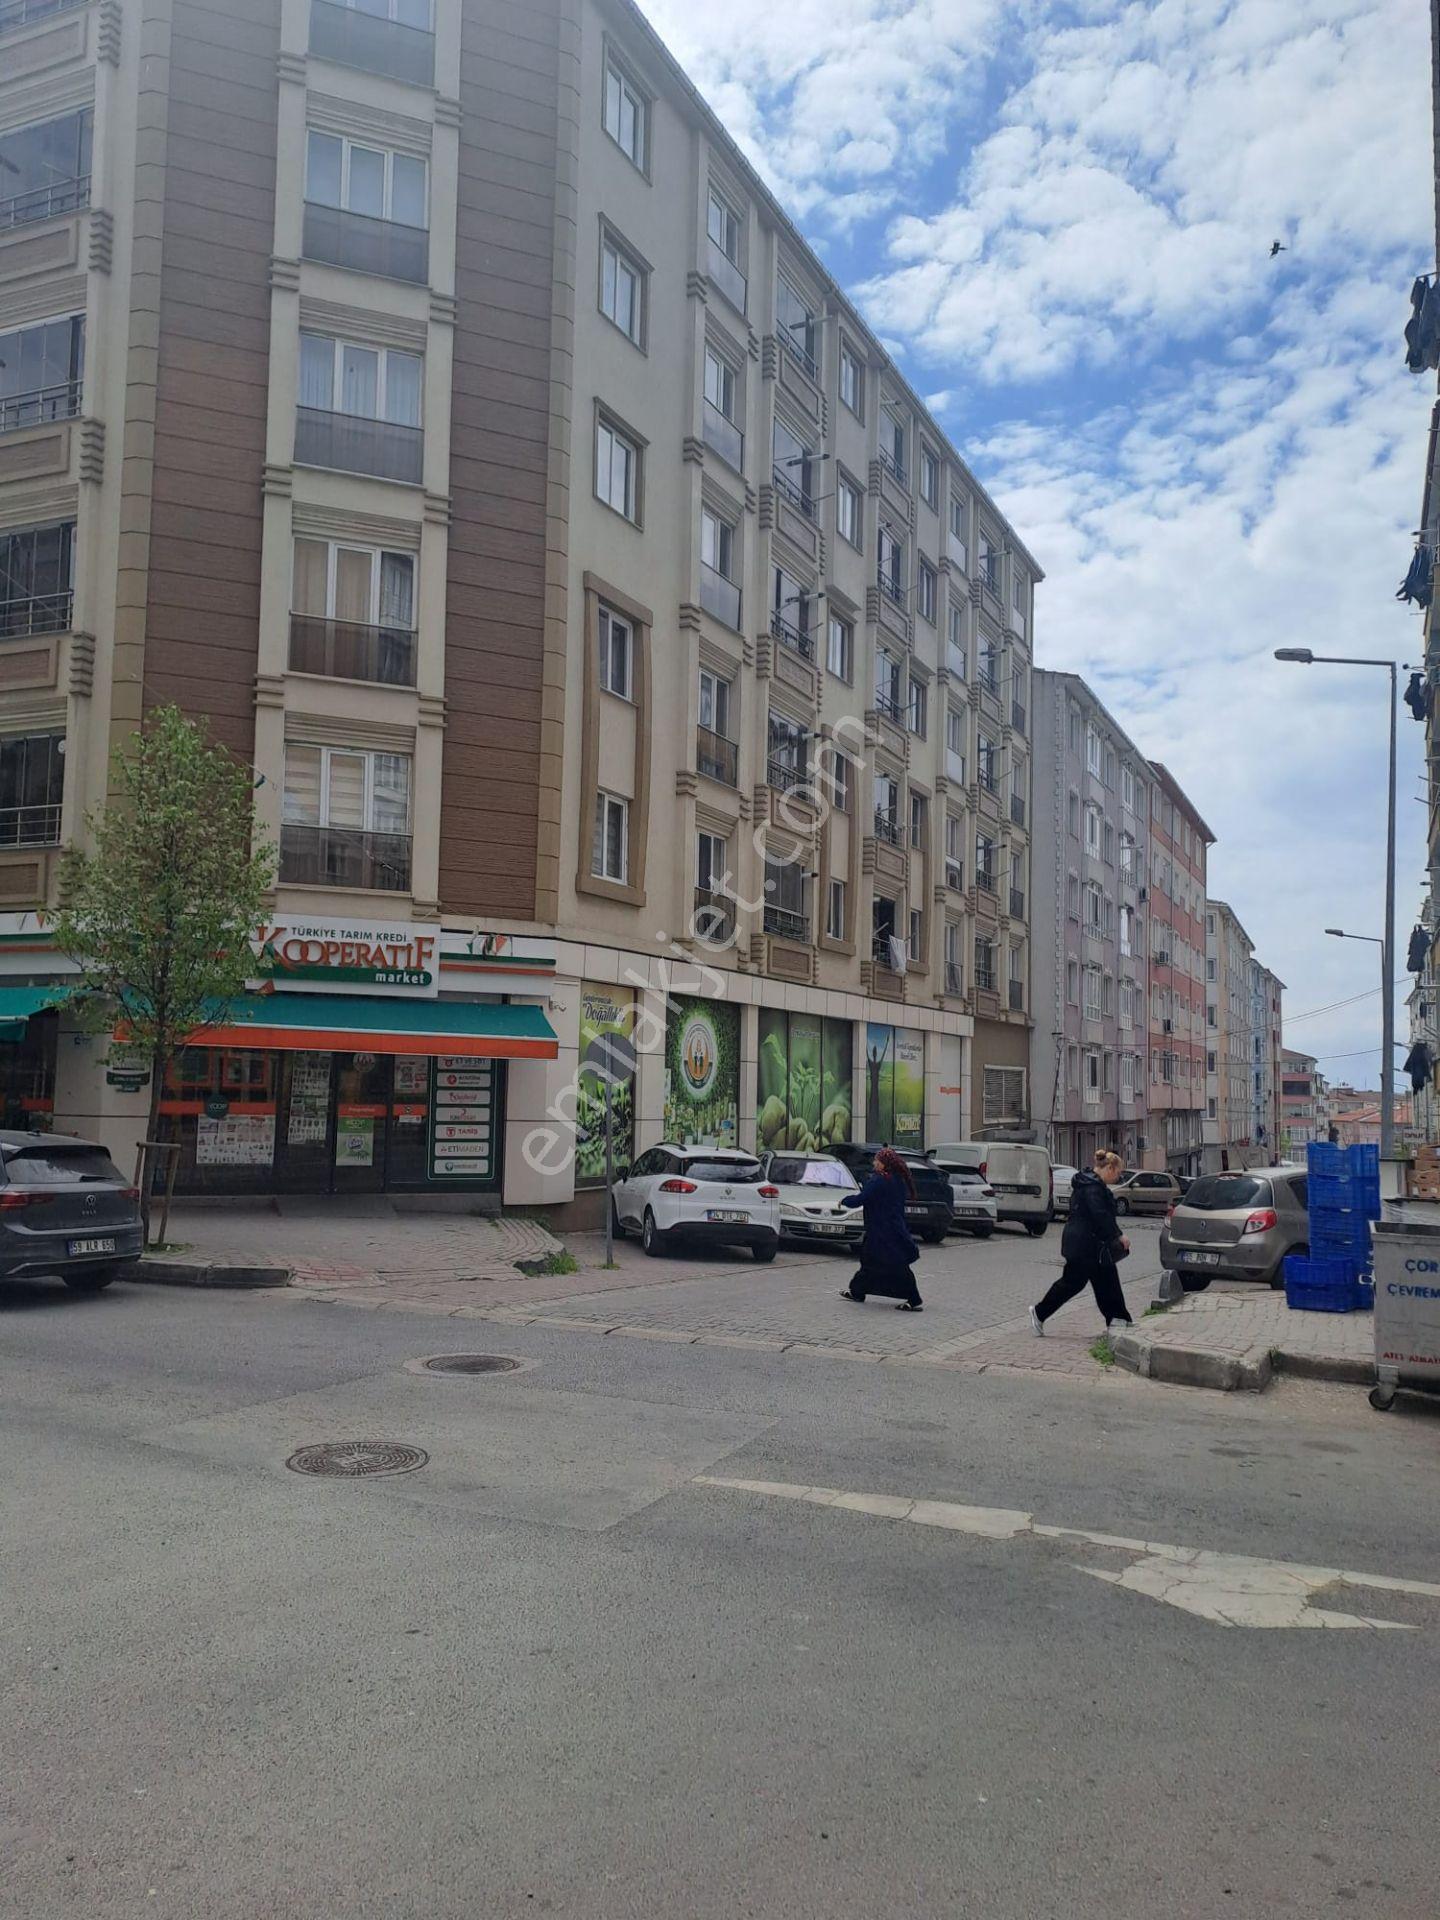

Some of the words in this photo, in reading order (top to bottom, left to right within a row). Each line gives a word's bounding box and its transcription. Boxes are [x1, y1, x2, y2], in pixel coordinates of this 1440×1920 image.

[291, 926, 336, 938] TÜRKİYE
[340, 929, 373, 941] TARIM
[376, 931, 408, 943] KREDİ
[375, 970, 426, 985] market
